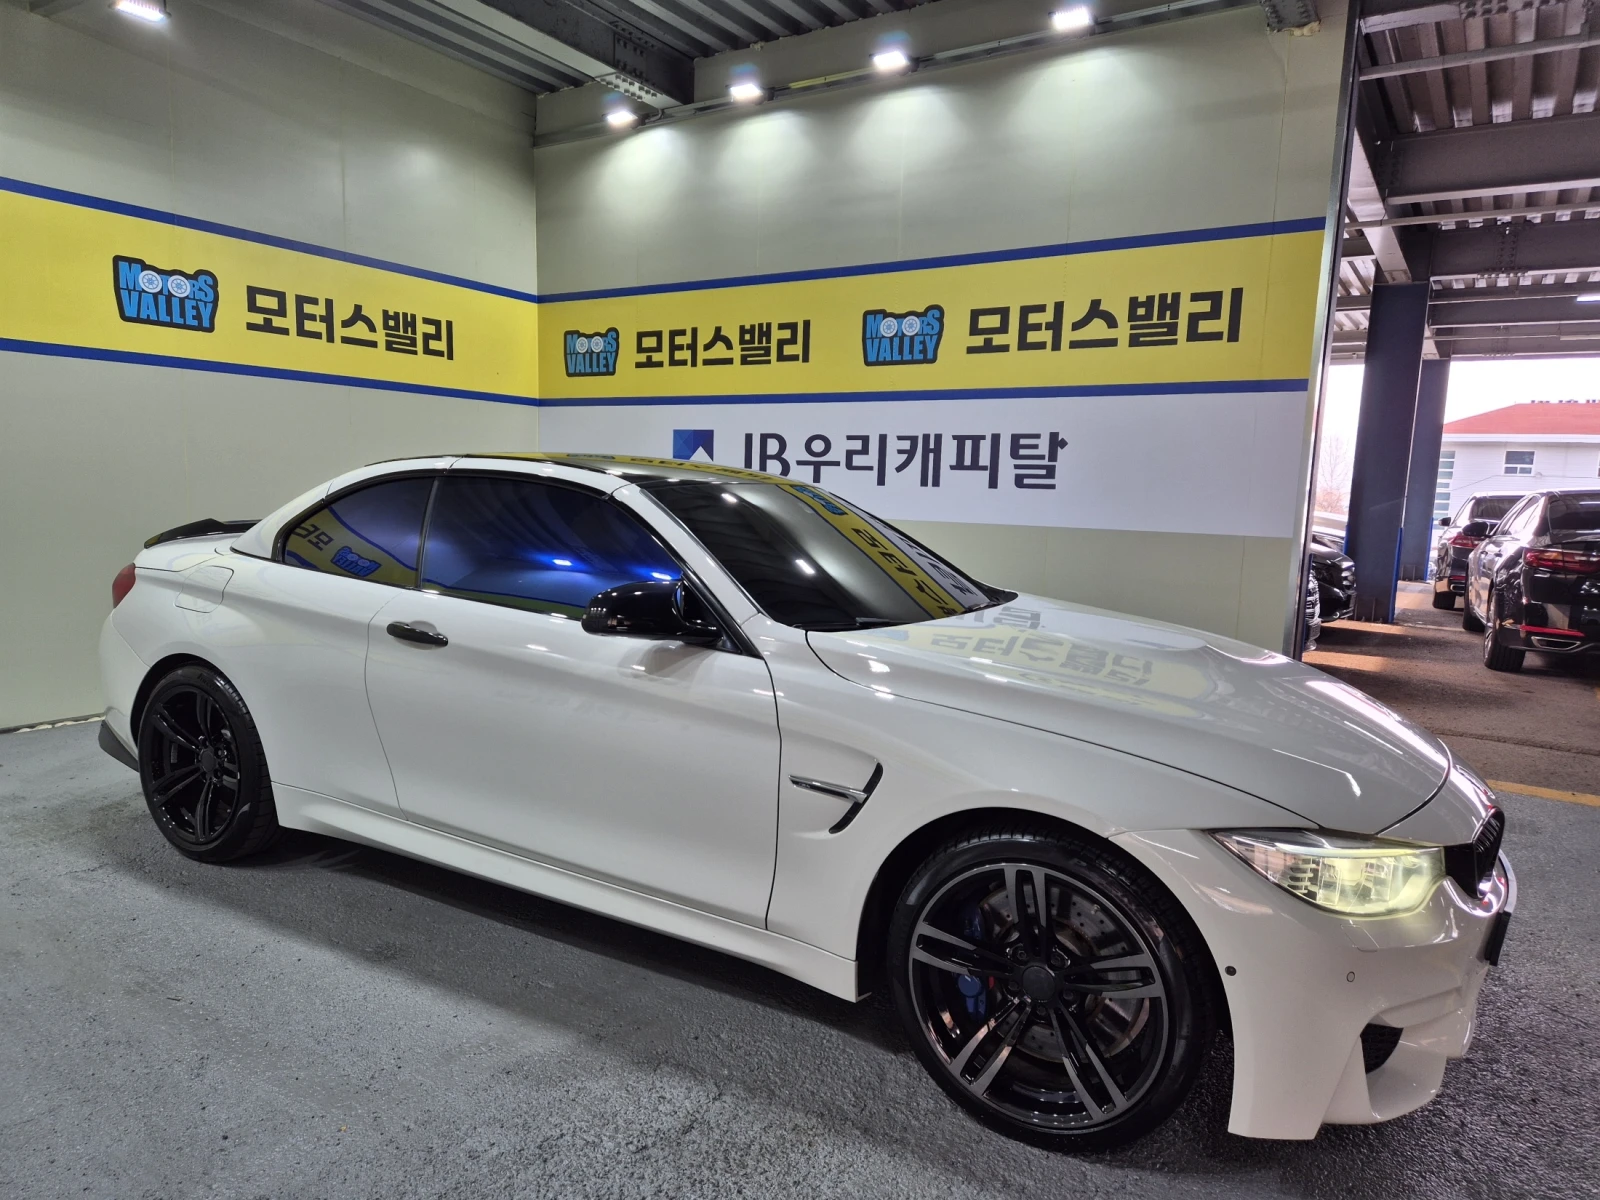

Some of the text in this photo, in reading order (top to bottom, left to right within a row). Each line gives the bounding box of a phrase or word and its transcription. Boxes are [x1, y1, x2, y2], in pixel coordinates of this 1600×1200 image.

[118, 260, 215, 303] MOTORS
[119, 288, 213, 328] VALLEY
[246, 284, 454, 361] 모터스밸리
[966, 287, 1244, 355] 모터스밸리
[566, 352, 616, 374] VALLEY
[634, 319, 811, 369] 모터스밸리
[865, 334, 939, 362] VALLEY
